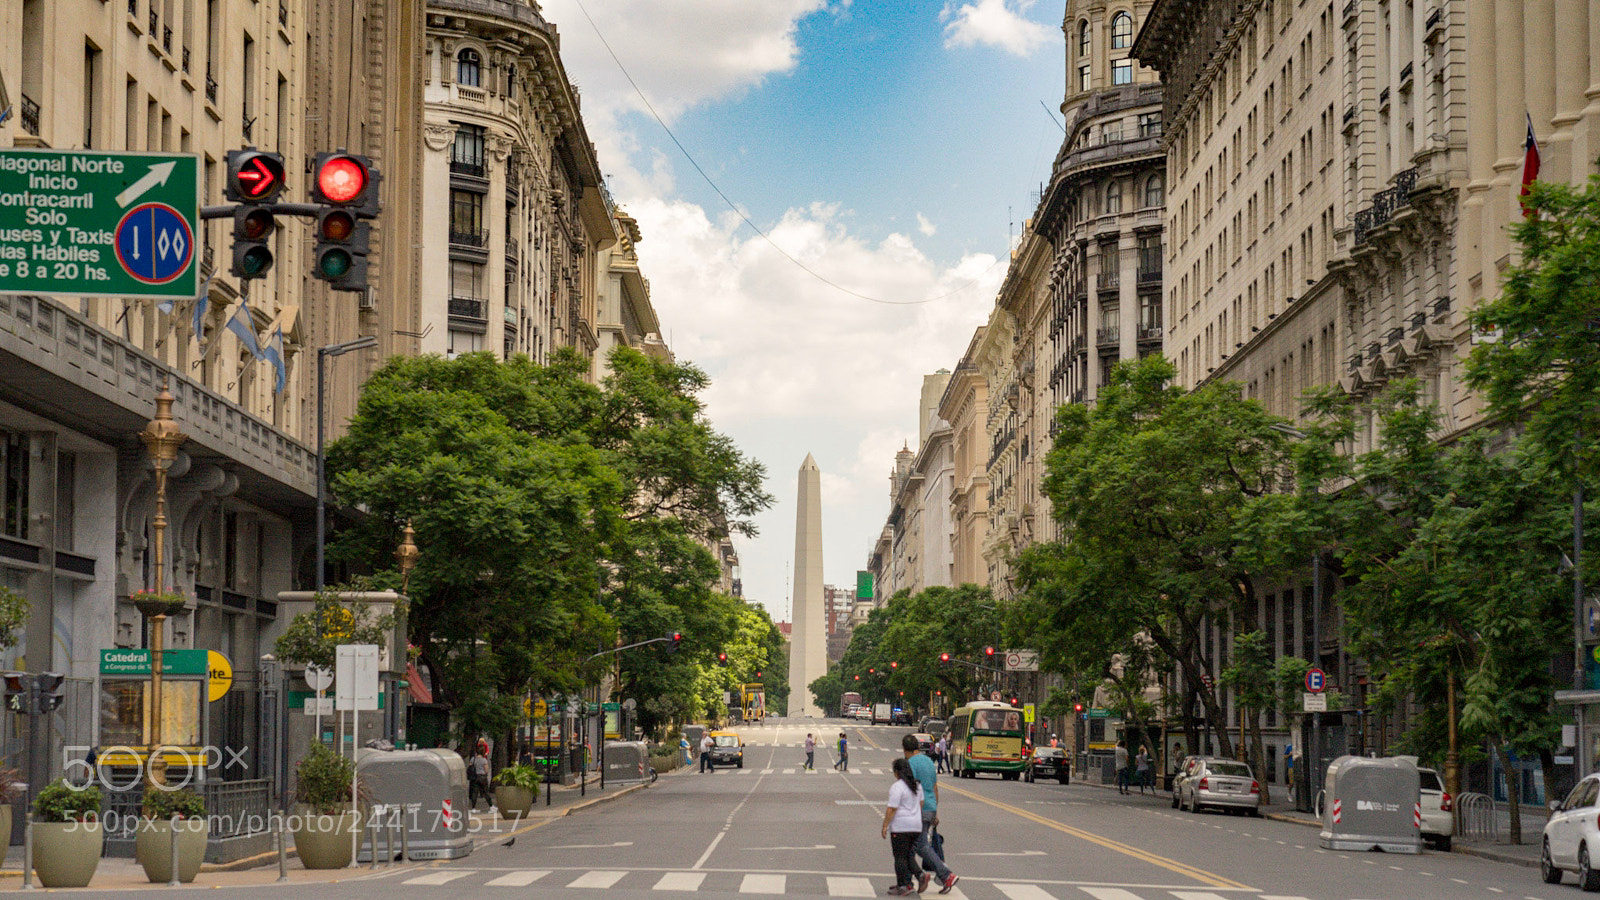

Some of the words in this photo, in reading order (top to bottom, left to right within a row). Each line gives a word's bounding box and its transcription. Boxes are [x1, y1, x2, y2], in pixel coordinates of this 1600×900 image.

[72, 156, 125, 174] Norte
[29, 173, 78, 190] Inicio
[0, 190, 93, 209] ontracarril
[25, 207, 68, 226] Solo
[0, 228, 43, 242] uses
[49, 230, 61, 246] y
[66, 227, 115, 245] Taxis
[0, 243, 27, 260] ías
[0, 263, 10, 277] e
[16, 261, 30, 278] 8
[35, 265, 48, 278] a
[53, 262, 79, 279] 20
[84, 264, 111, 280] hs.
[104, 652, 147, 662] Catedral
[1311, 672, 1321, 690] E
